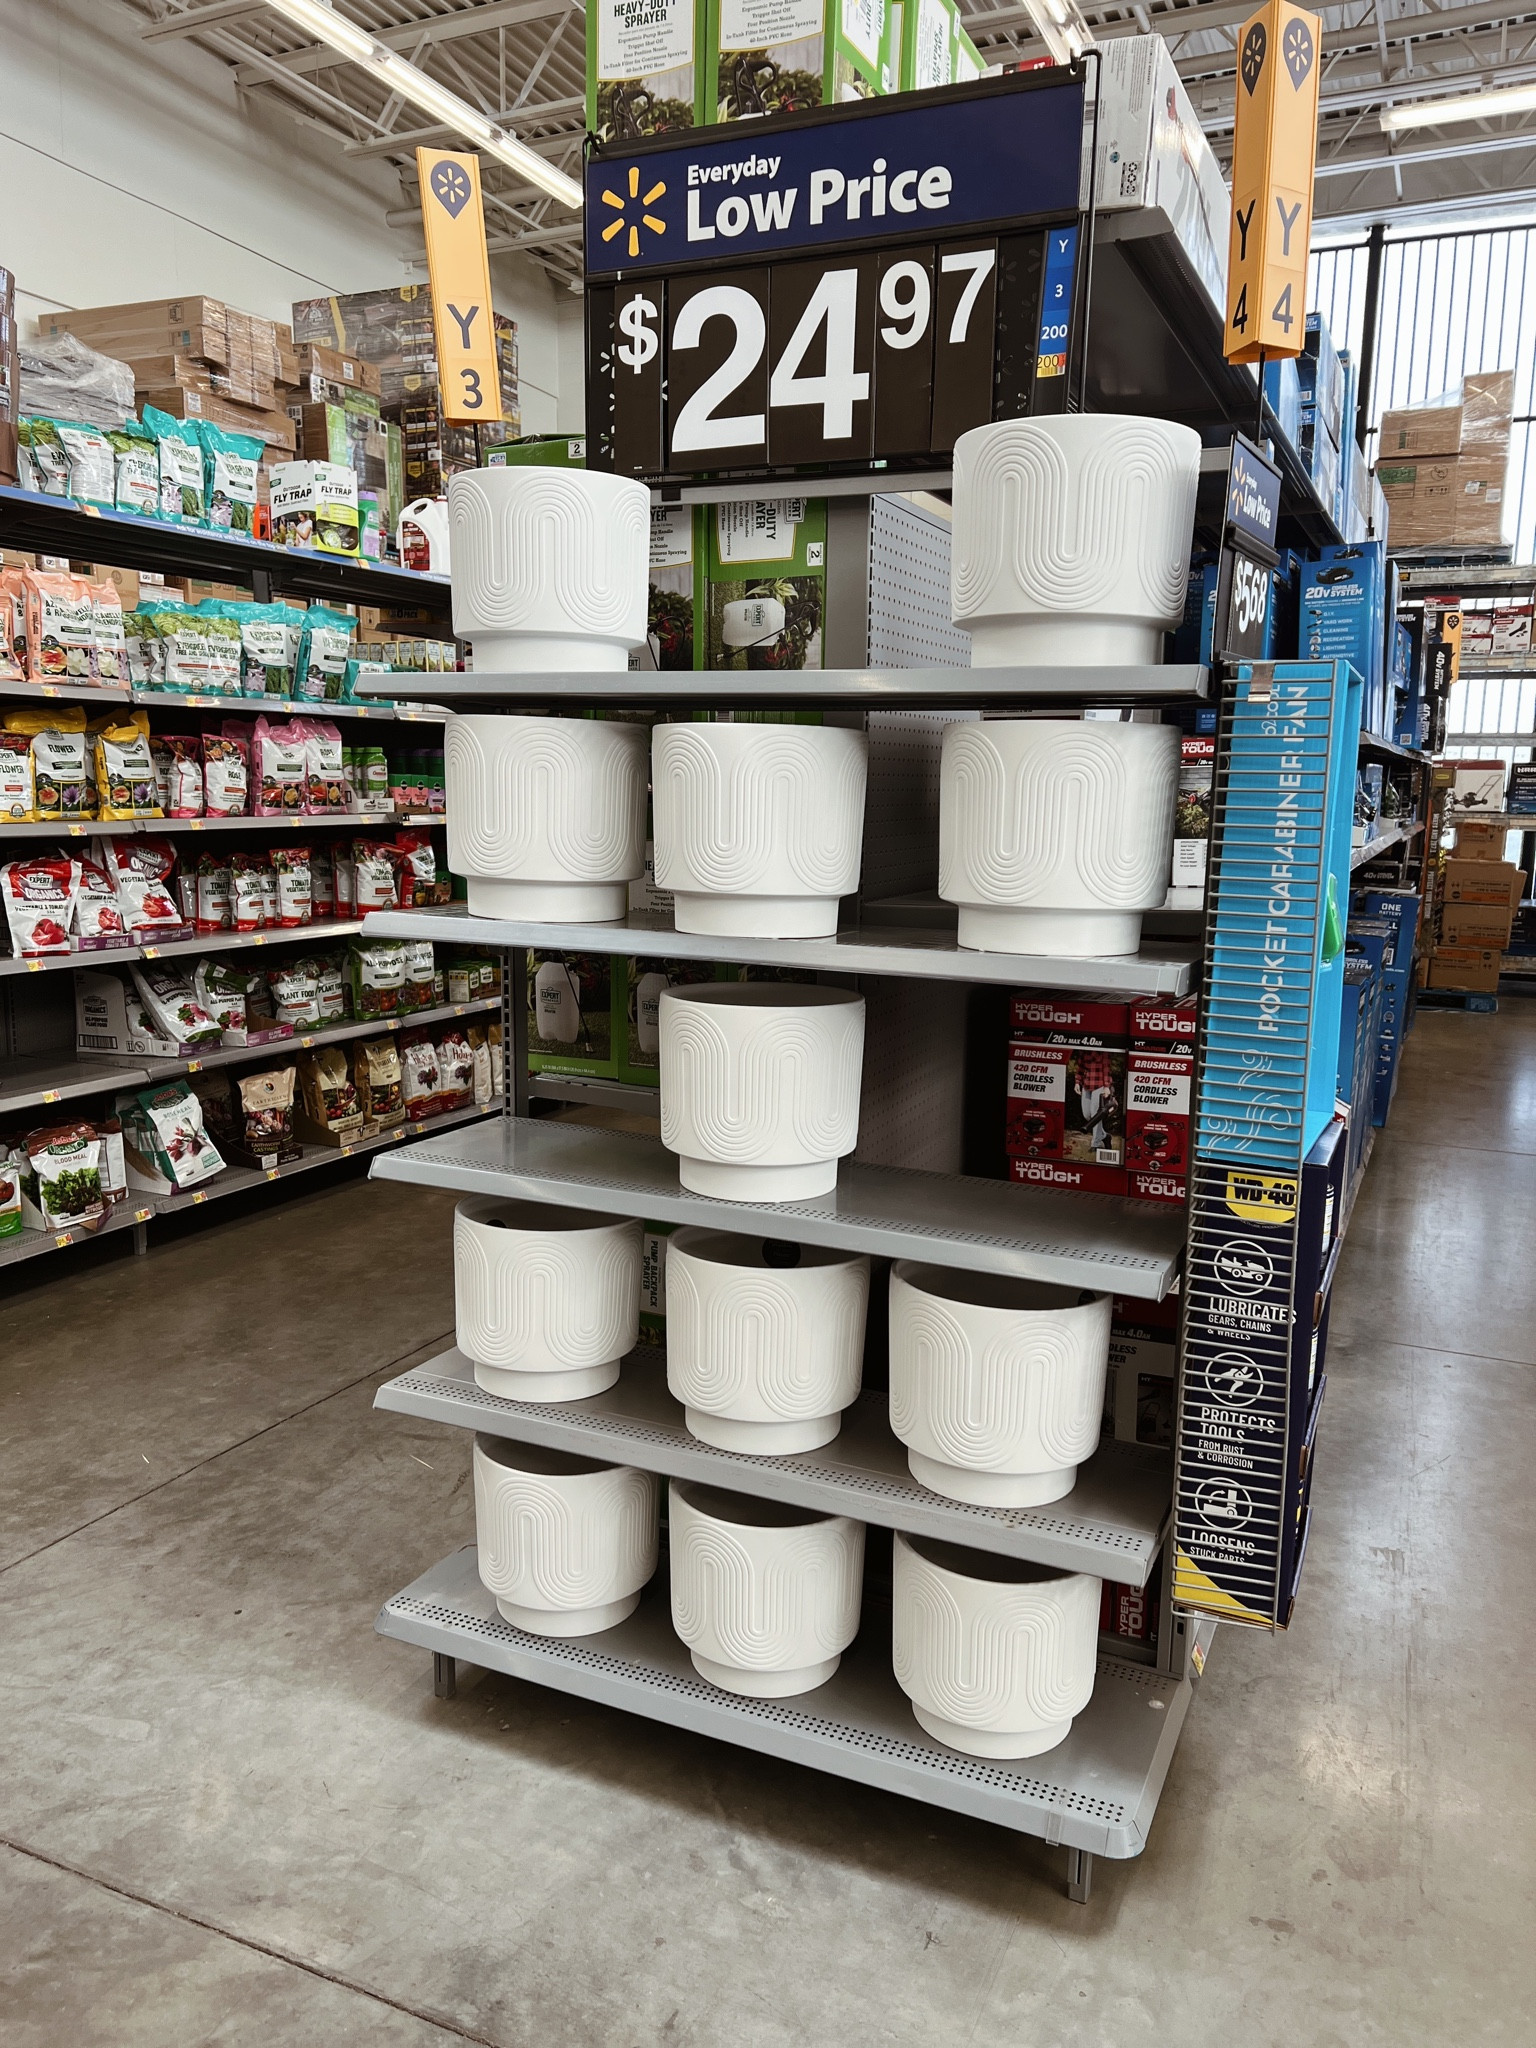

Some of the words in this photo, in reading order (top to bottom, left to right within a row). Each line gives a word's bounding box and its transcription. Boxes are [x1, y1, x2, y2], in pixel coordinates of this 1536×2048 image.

[624, 9, 668, 29] SPRAYER
[752, 11, 769, 19] Trigger
[766, 23, 792, 33] Continuous
[794, 18, 817, 29] Spraying
[627, 42, 645, 50] Trigger
[667, 50, 688, 60] Spraying
[687, 155, 781, 185] Everyday
[687, 187, 797, 241] Low
[810, 158, 953, 226] Price
[1236, 199, 1256, 262] Y
[1276, 196, 1302, 256] Y
[1059, 238, 1069, 254] Y
[1055, 284, 1064, 298] 3
[1232, 283, 1249, 335] 4
[1272, 283, 1294, 334] 4
[446, 304, 479, 349] Y
[1041, 324, 1068, 340] 200
[460, 368, 483, 410] 3
[573, 444, 582, 454] 2
[274, 493, 289, 504] FLY
[290, 488, 312, 500] TRAP
[335, 487, 352, 495] TRAP
[1243, 485, 1256, 519] Low
[1255, 495, 1272, 529] Price
[811, 551, 820, 559] 2
[1331, 588, 1364, 597] SYSTEM
[1283, 686, 1309, 743] FAN
[48, 744, 76, 753] FLOWER
[29, 876, 51, 885] EXPERT
[25, 887, 66, 900] ORGANICS
[1381, 903, 1402, 911] ONE
[279, 992, 299, 1001] PLANT
[301, 990, 315, 998] FOOD
[541, 992, 560, 1000] EXPERT
[1015, 1003, 1053, 1011] HYPER
[1015, 1010, 1082, 1024] TOUGH
[1136, 1011, 1177, 1020] HYPER
[1014, 1049, 1063, 1060] BRUSHLESS
[1014, 1064, 1029, 1073] 420
[1031, 1065, 1048, 1074] CFM
[1134, 1059, 1187, 1071] BRUSHLESS
[1013, 1073, 1054, 1084] CORDLESS
[1134, 1075, 1150, 1084] 420
[1152, 1077, 1172, 1086] CFM
[1013, 1083, 1046, 1093] BLOWER
[1133, 1085, 1178, 1096] CORDLESS
[1133, 1094, 1169, 1105] BLOWER
[1015, 1161, 1053, 1170] HYPER
[1015, 1168, 1081, 1184] TOUGH
[1136, 1175, 1176, 1186] HYPER
[1233, 1177, 1296, 1207] WD-40
[650, 1240, 659, 1263] PUMP
[642, 1255, 651, 1291] SPRAYER
[650, 1265, 659, 1308] BACKPACK
[1210, 1296, 1297, 1325] LUBRICATES
[1208, 1314, 1238, 1328] GEARS,
[1240, 1319, 1272, 1334] CHAINS
[1217, 1329, 1251, 1341] WHEELS
[1109, 1344, 1137, 1355] DLESS
[1201, 1406, 1276, 1435] PROTECTS
[1200, 1422, 1246, 1445] TOOLS
[1198, 1439, 1222, 1452] FROM
[1224, 1442, 1245, 1456] RUST
[1197, 1451, 1204, 1460] &
[1206, 1453, 1253, 1470] CORROSION
[1191, 1529, 1255, 1557] LOOSENS
[1190, 1546, 1217, 1559] STUCK
[1218, 1550, 1245, 1564] PARTS
